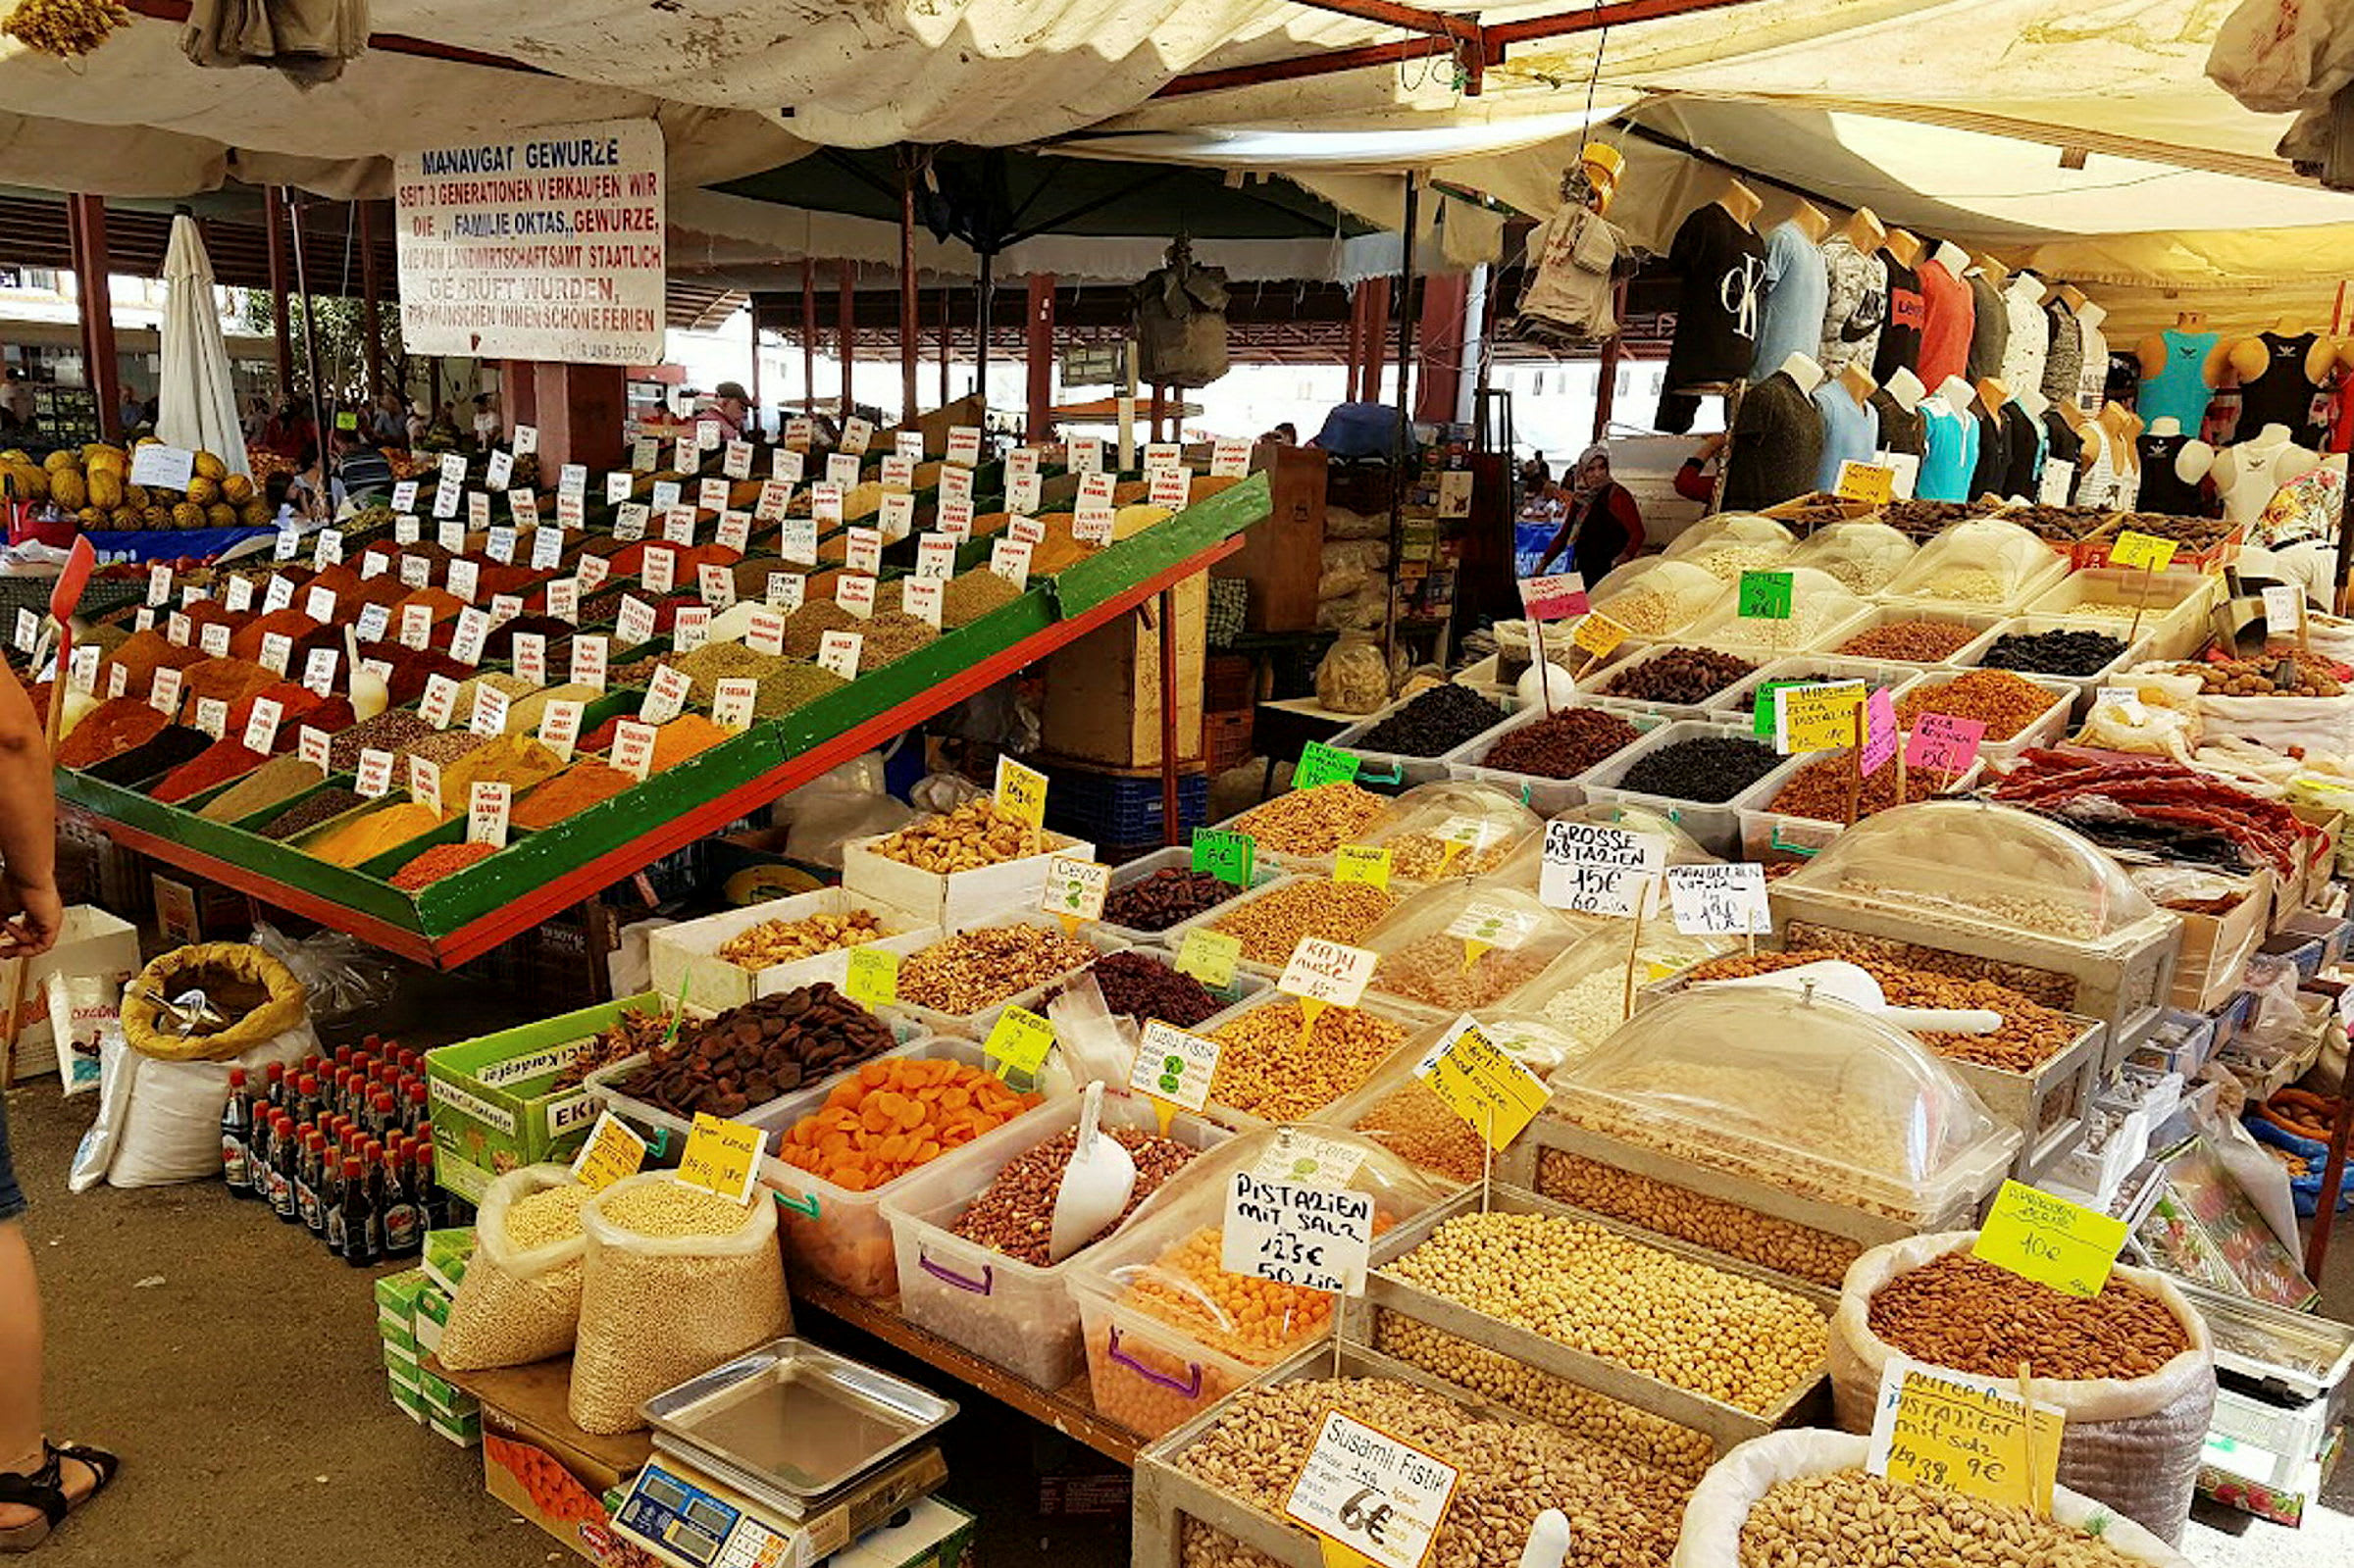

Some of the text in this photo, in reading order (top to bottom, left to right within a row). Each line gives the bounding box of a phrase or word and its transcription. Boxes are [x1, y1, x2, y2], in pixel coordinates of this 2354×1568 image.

[422, 146, 514, 176] MANAVGAT
[439, 178, 534, 206] GENERATIONEN
[537, 173, 621, 200] VERKAUFEN
[629, 172, 657, 197] WIR
[412, 216, 435, 237] DIE
[588, 244, 661, 269] STAATLICH
[601, 307, 654, 332] FERIEN
[1552, 822, 1638, 850] GROSSE
[1338, 1488, 1395, 1546] 6€
